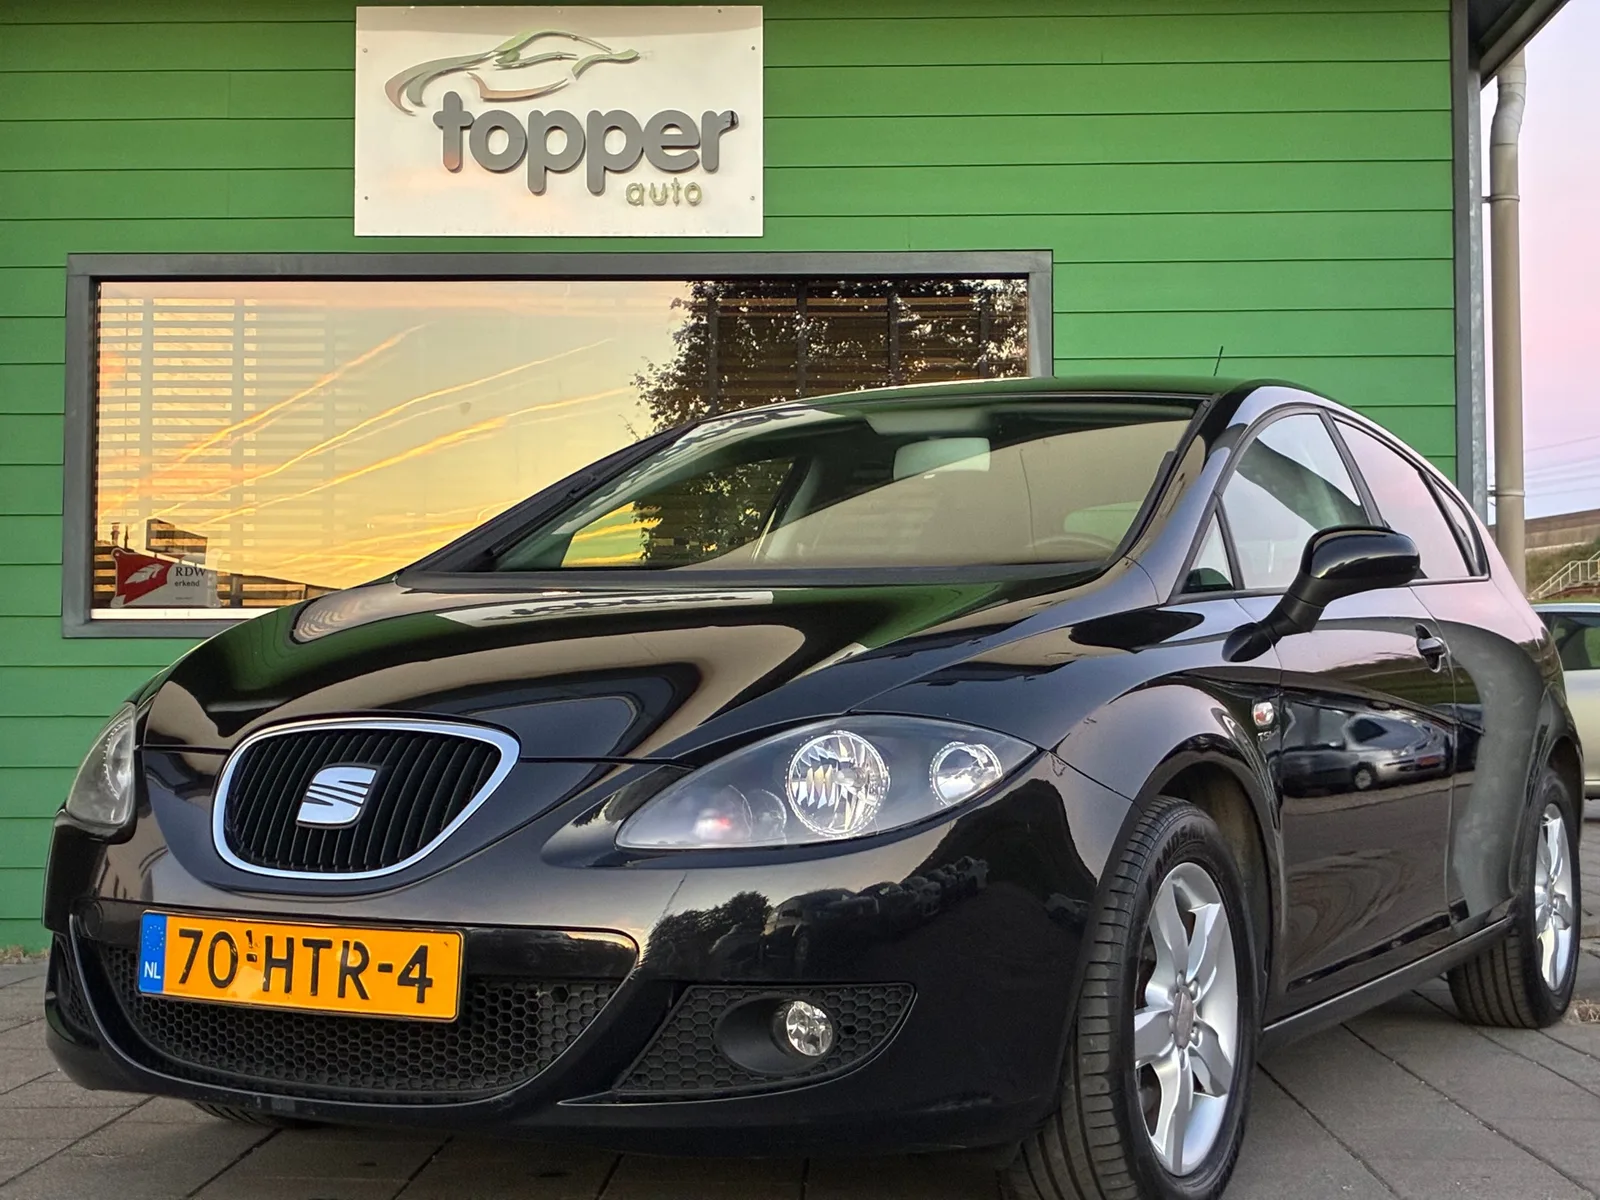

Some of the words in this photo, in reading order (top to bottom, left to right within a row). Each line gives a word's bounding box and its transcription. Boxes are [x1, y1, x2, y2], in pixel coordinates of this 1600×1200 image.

[433, 90, 739, 196] topper
[626, 178, 703, 207] auto
[174, 579, 200, 587] erkend
[175, 566, 206, 577] RDW
[143, 961, 161, 979] NL
[178, 928, 433, 1003] 70-HTR-4
